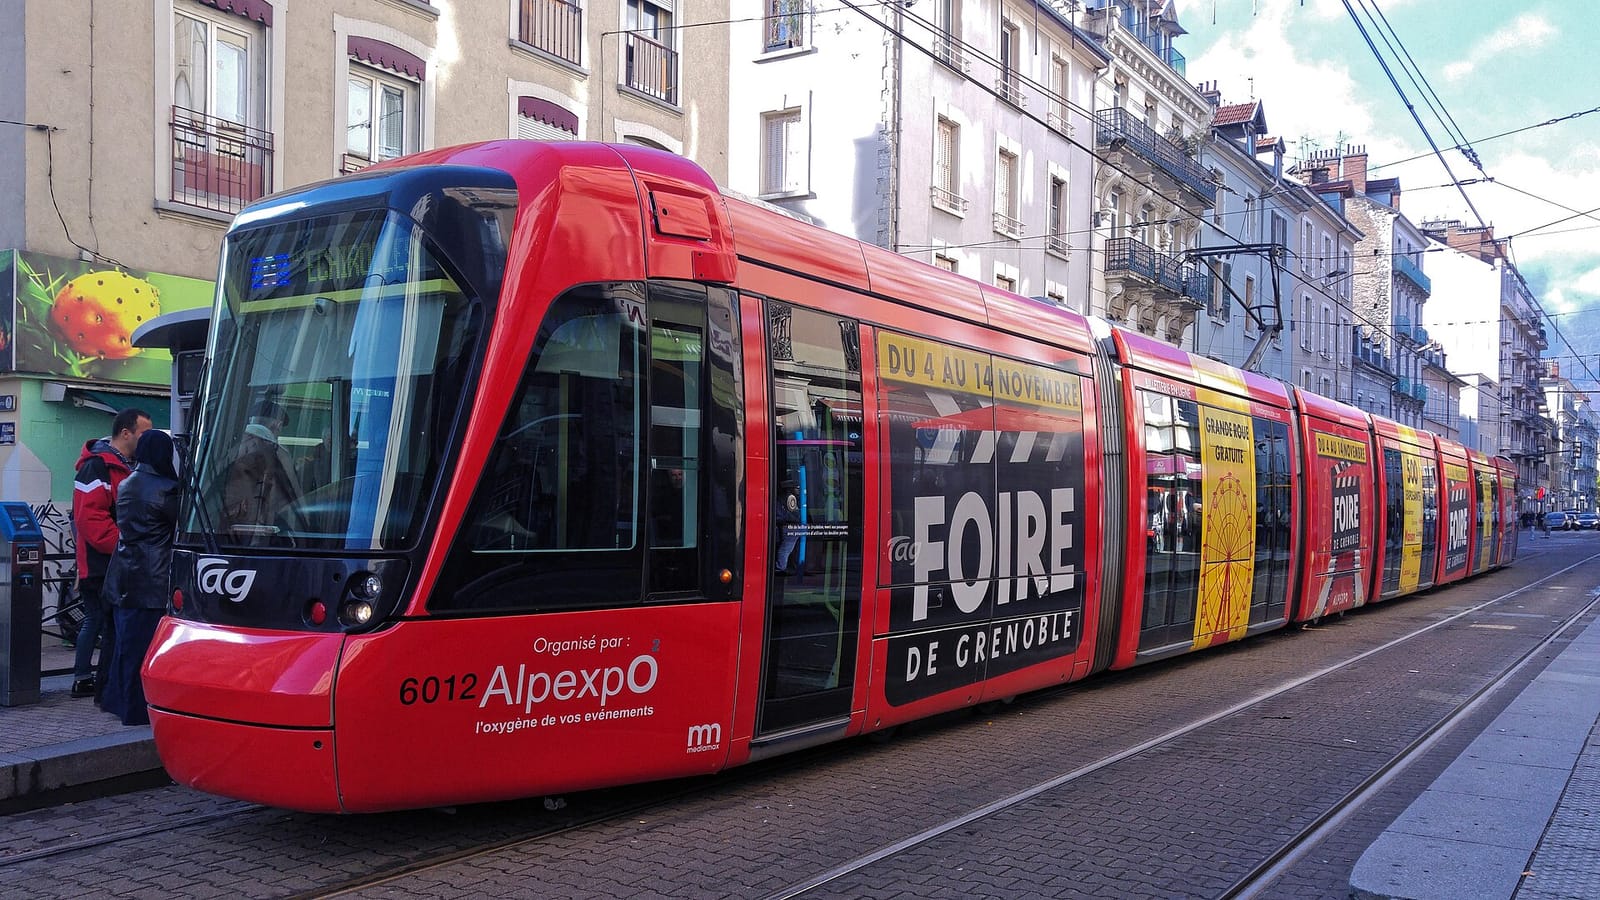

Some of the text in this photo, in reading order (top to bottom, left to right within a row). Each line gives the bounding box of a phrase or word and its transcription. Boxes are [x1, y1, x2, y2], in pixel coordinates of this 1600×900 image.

[888, 344, 1079, 407] DU 4 AU 14 NOVEMBRE
[1205, 417, 1249, 441] GRANDE ROUE
[1215, 445, 1244, 464] GRATUITE
[1406, 457, 1419, 485] 500
[1334, 493, 1359, 534] FOIRE
[1448, 507, 1467, 551] FOIRE
[912, 487, 1075, 622] FOIRE
[533, 635, 597, 656] Organisé
[600, 637, 624, 653] par
[906, 611, 1073, 682] DE GRENOBLE
[399, 673, 478, 706] 6012
[475, 705, 655, 735] l'oxygène de vos evénements
[686, 743, 720, 754] mediamax
